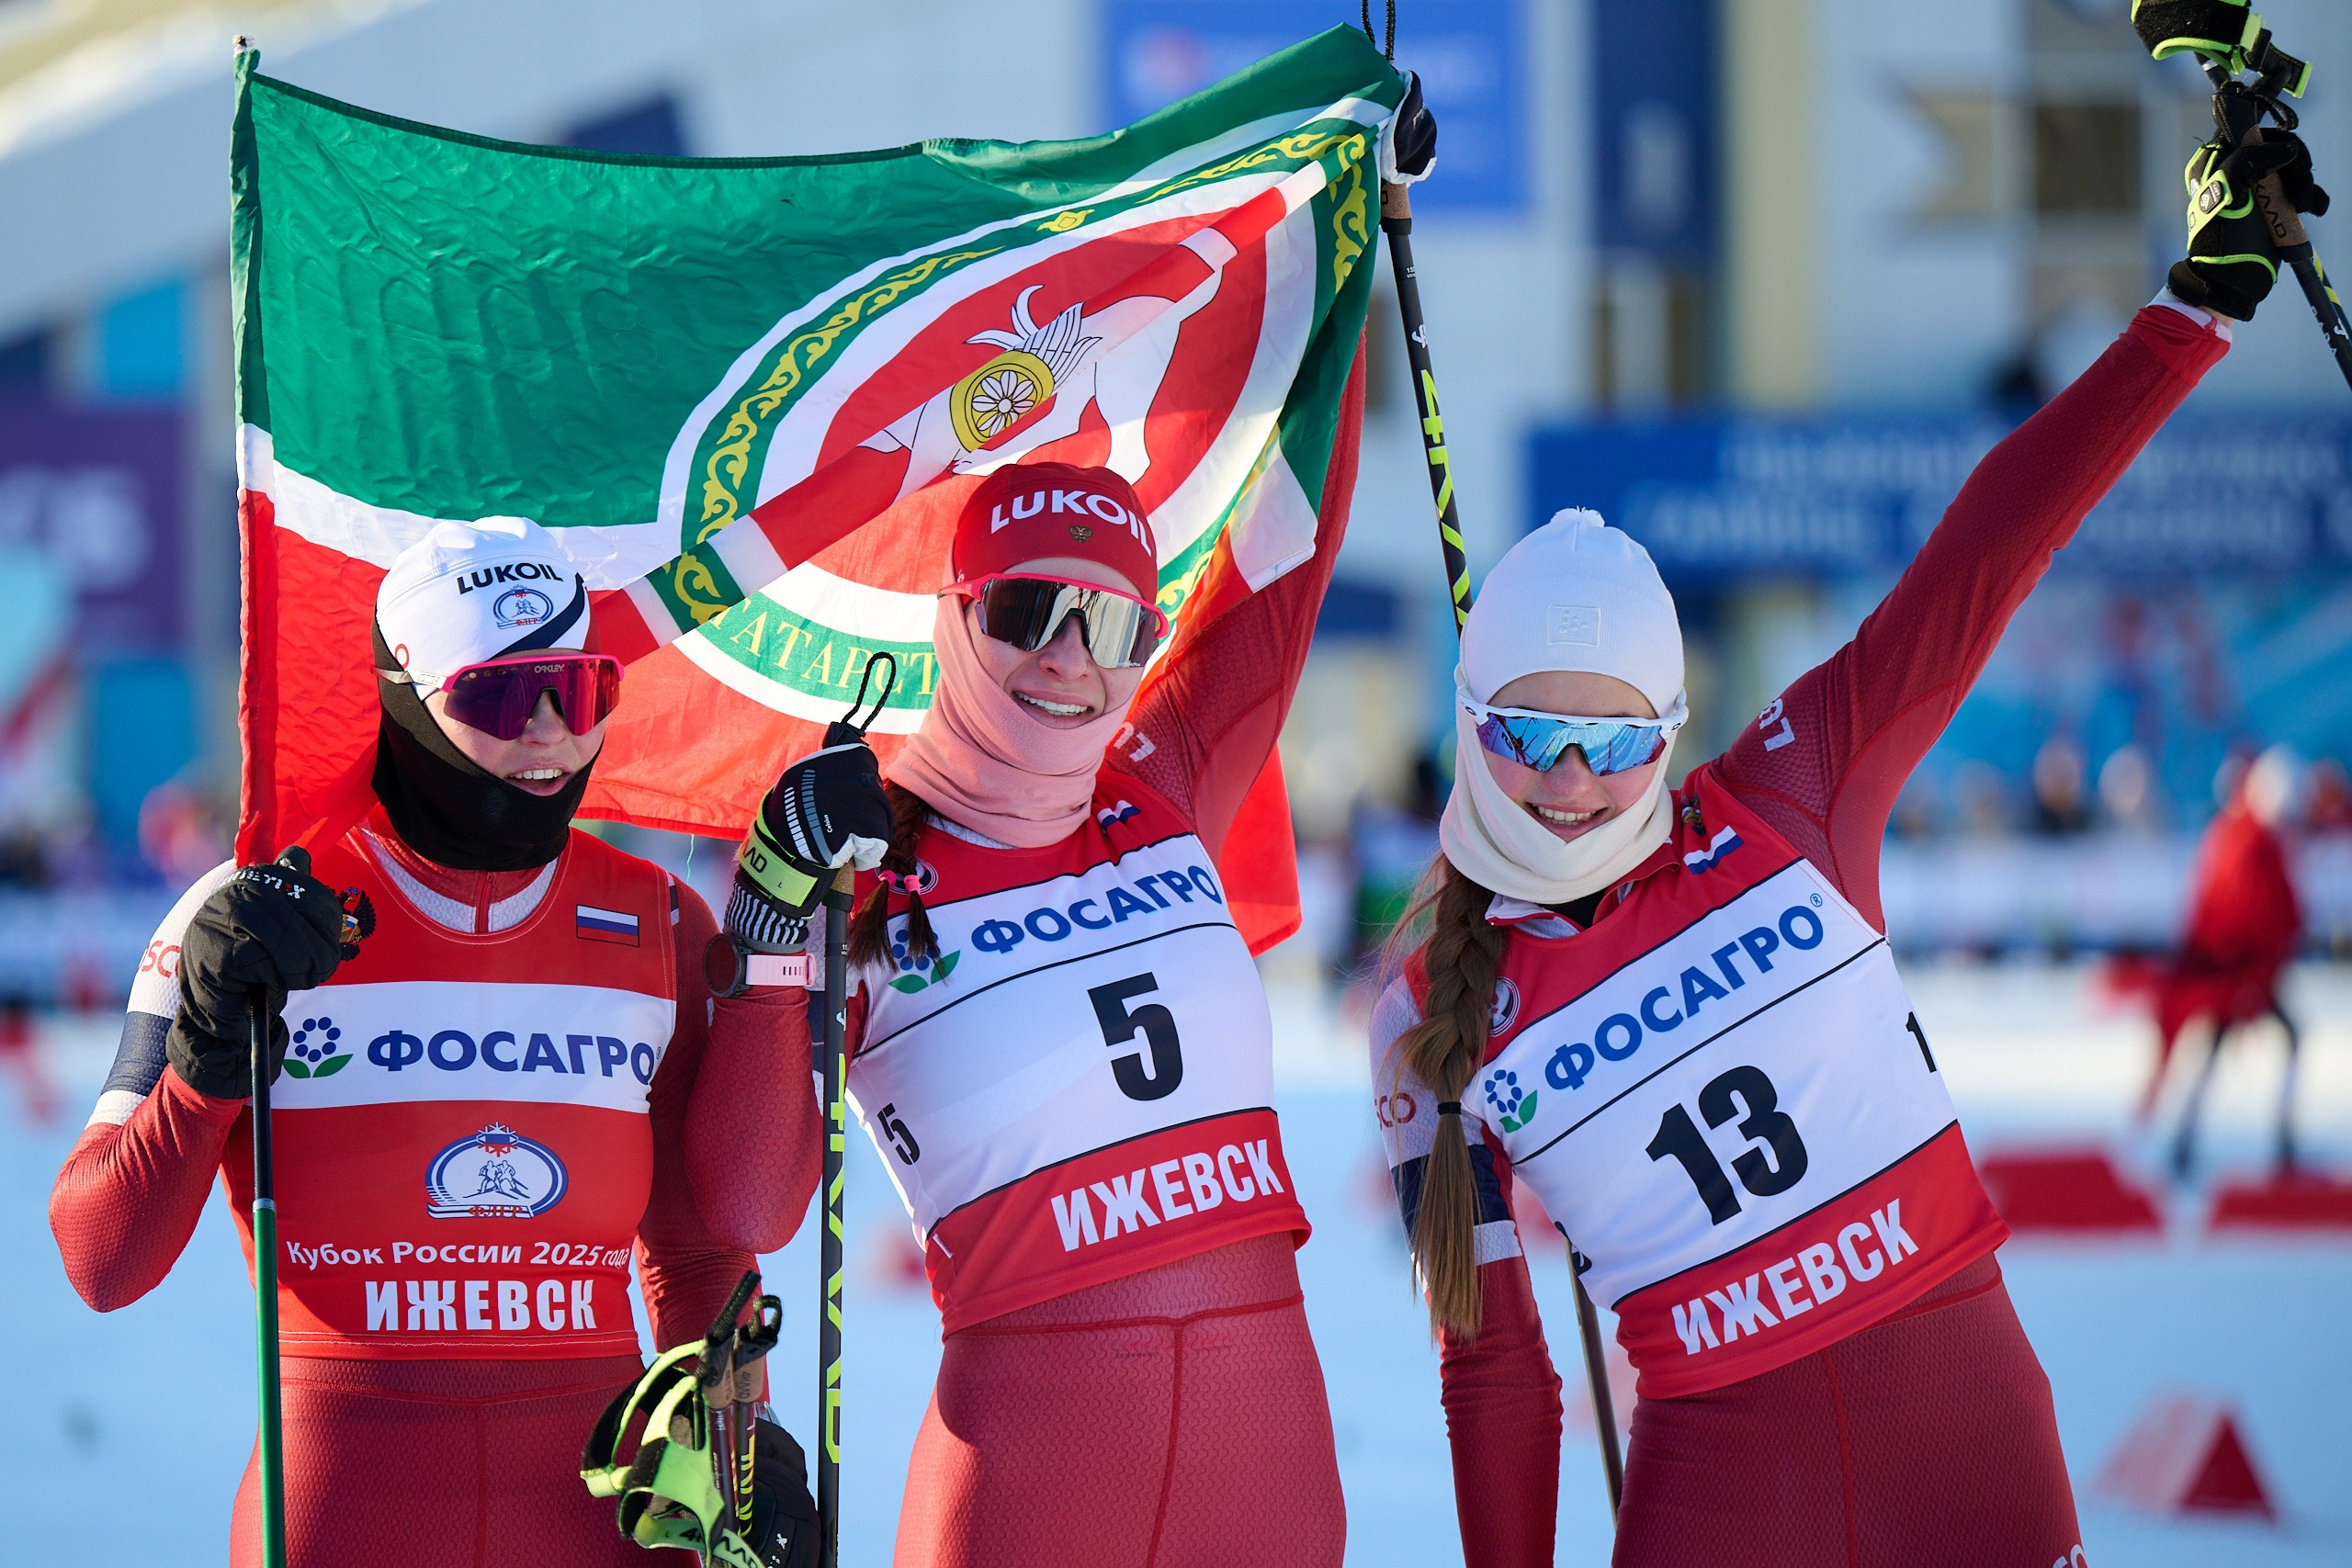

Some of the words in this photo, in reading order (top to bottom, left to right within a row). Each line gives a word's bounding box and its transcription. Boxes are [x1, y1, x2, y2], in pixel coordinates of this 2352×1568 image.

[990, 490, 1152, 558] LUKOIL
[457, 562, 564, 595] LUKOIL
[534, 663, 565, 674] OAKLEY
[970, 862, 1223, 955] ФОСАГРО
[139, 939, 181, 979] SC
[1544, 904, 1825, 1093] ФОСАГРО
[368, 1030, 654, 1086] ФОСАГРО
[1087, 972, 1184, 1101] 5
[876, 1103, 921, 1167] 5
[1374, 1092, 1417, 1131] CO
[1645, 1066, 1810, 1226] 13
[1050, 1139, 1284, 1252] ИЖЕВСК
[287, 1240, 385, 1270] Кубок
[392, 1242, 522, 1264] России
[529, 1241, 604, 1267] 2025
[601, 1247, 630, 1269] года
[1671, 1198, 1919, 1356] ИЖЕВСК
[365, 1279, 598, 1331] ИЖЕВСК
